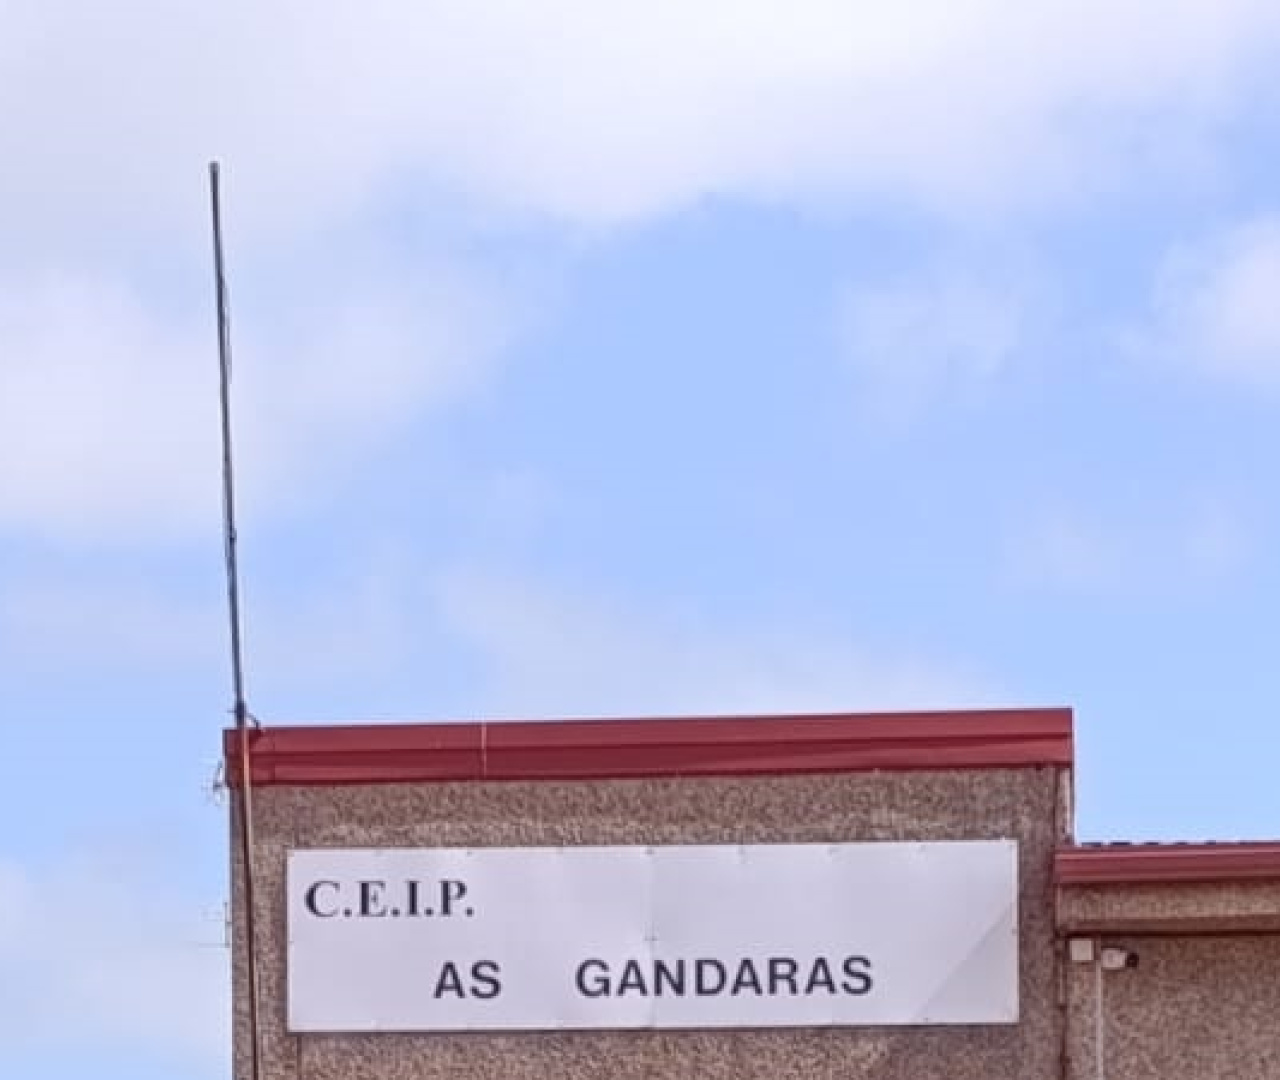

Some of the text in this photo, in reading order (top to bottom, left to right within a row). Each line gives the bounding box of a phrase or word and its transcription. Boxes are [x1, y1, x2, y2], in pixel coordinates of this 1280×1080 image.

[304, 879, 475, 918] C.E.I.P.
[434, 956, 873, 999] AS GANDARAS
